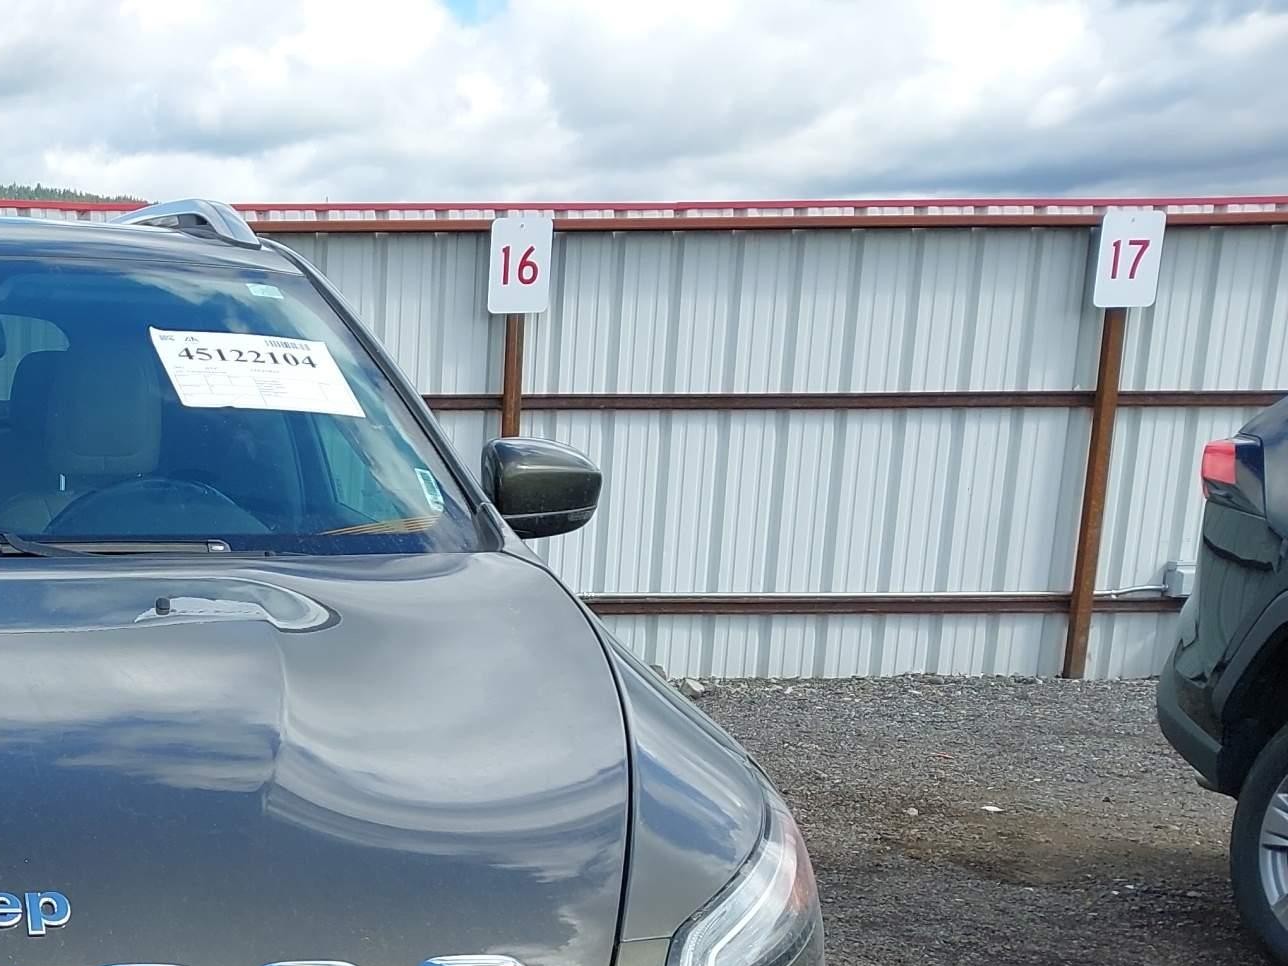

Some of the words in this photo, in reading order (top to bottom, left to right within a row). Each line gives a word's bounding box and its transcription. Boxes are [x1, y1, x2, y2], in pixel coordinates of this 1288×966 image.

[502, 246, 539, 285] 16
[1111, 239, 1150, 279] 17
[178, 347, 317, 368] 45122104
